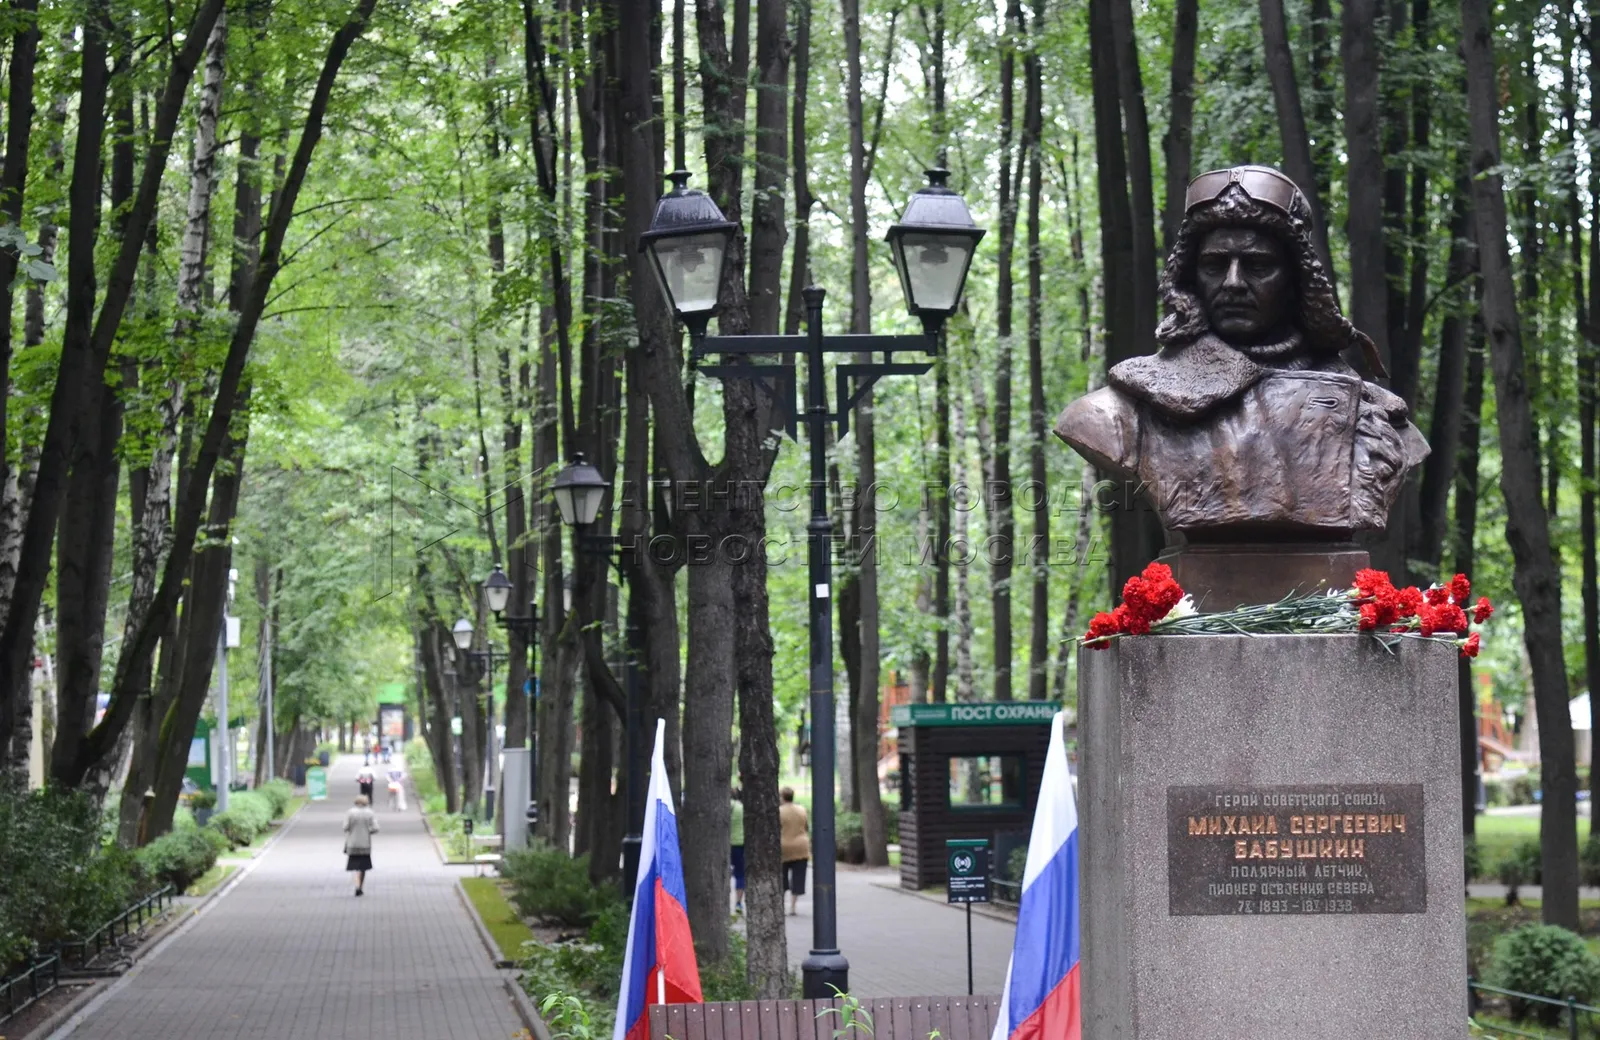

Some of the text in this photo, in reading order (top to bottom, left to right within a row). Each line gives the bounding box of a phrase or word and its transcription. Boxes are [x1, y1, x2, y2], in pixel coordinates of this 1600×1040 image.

[951, 705, 992, 720] ПОСТ
[1215, 792, 1386, 807] ГЕРОЙ СОВЕТСКОГО СОЮЗА
[1187, 814, 1407, 835] МИХАИЛ СЕРГЕЕВИЧ
[1234, 839, 1365, 859] БАБУШКИН
[1231, 863, 1306, 878] ПОЛЯРНЫЙ
[1208, 881, 1375, 896] ПИОНЕР ОСВОЕНИЯ СЕВЕРА
